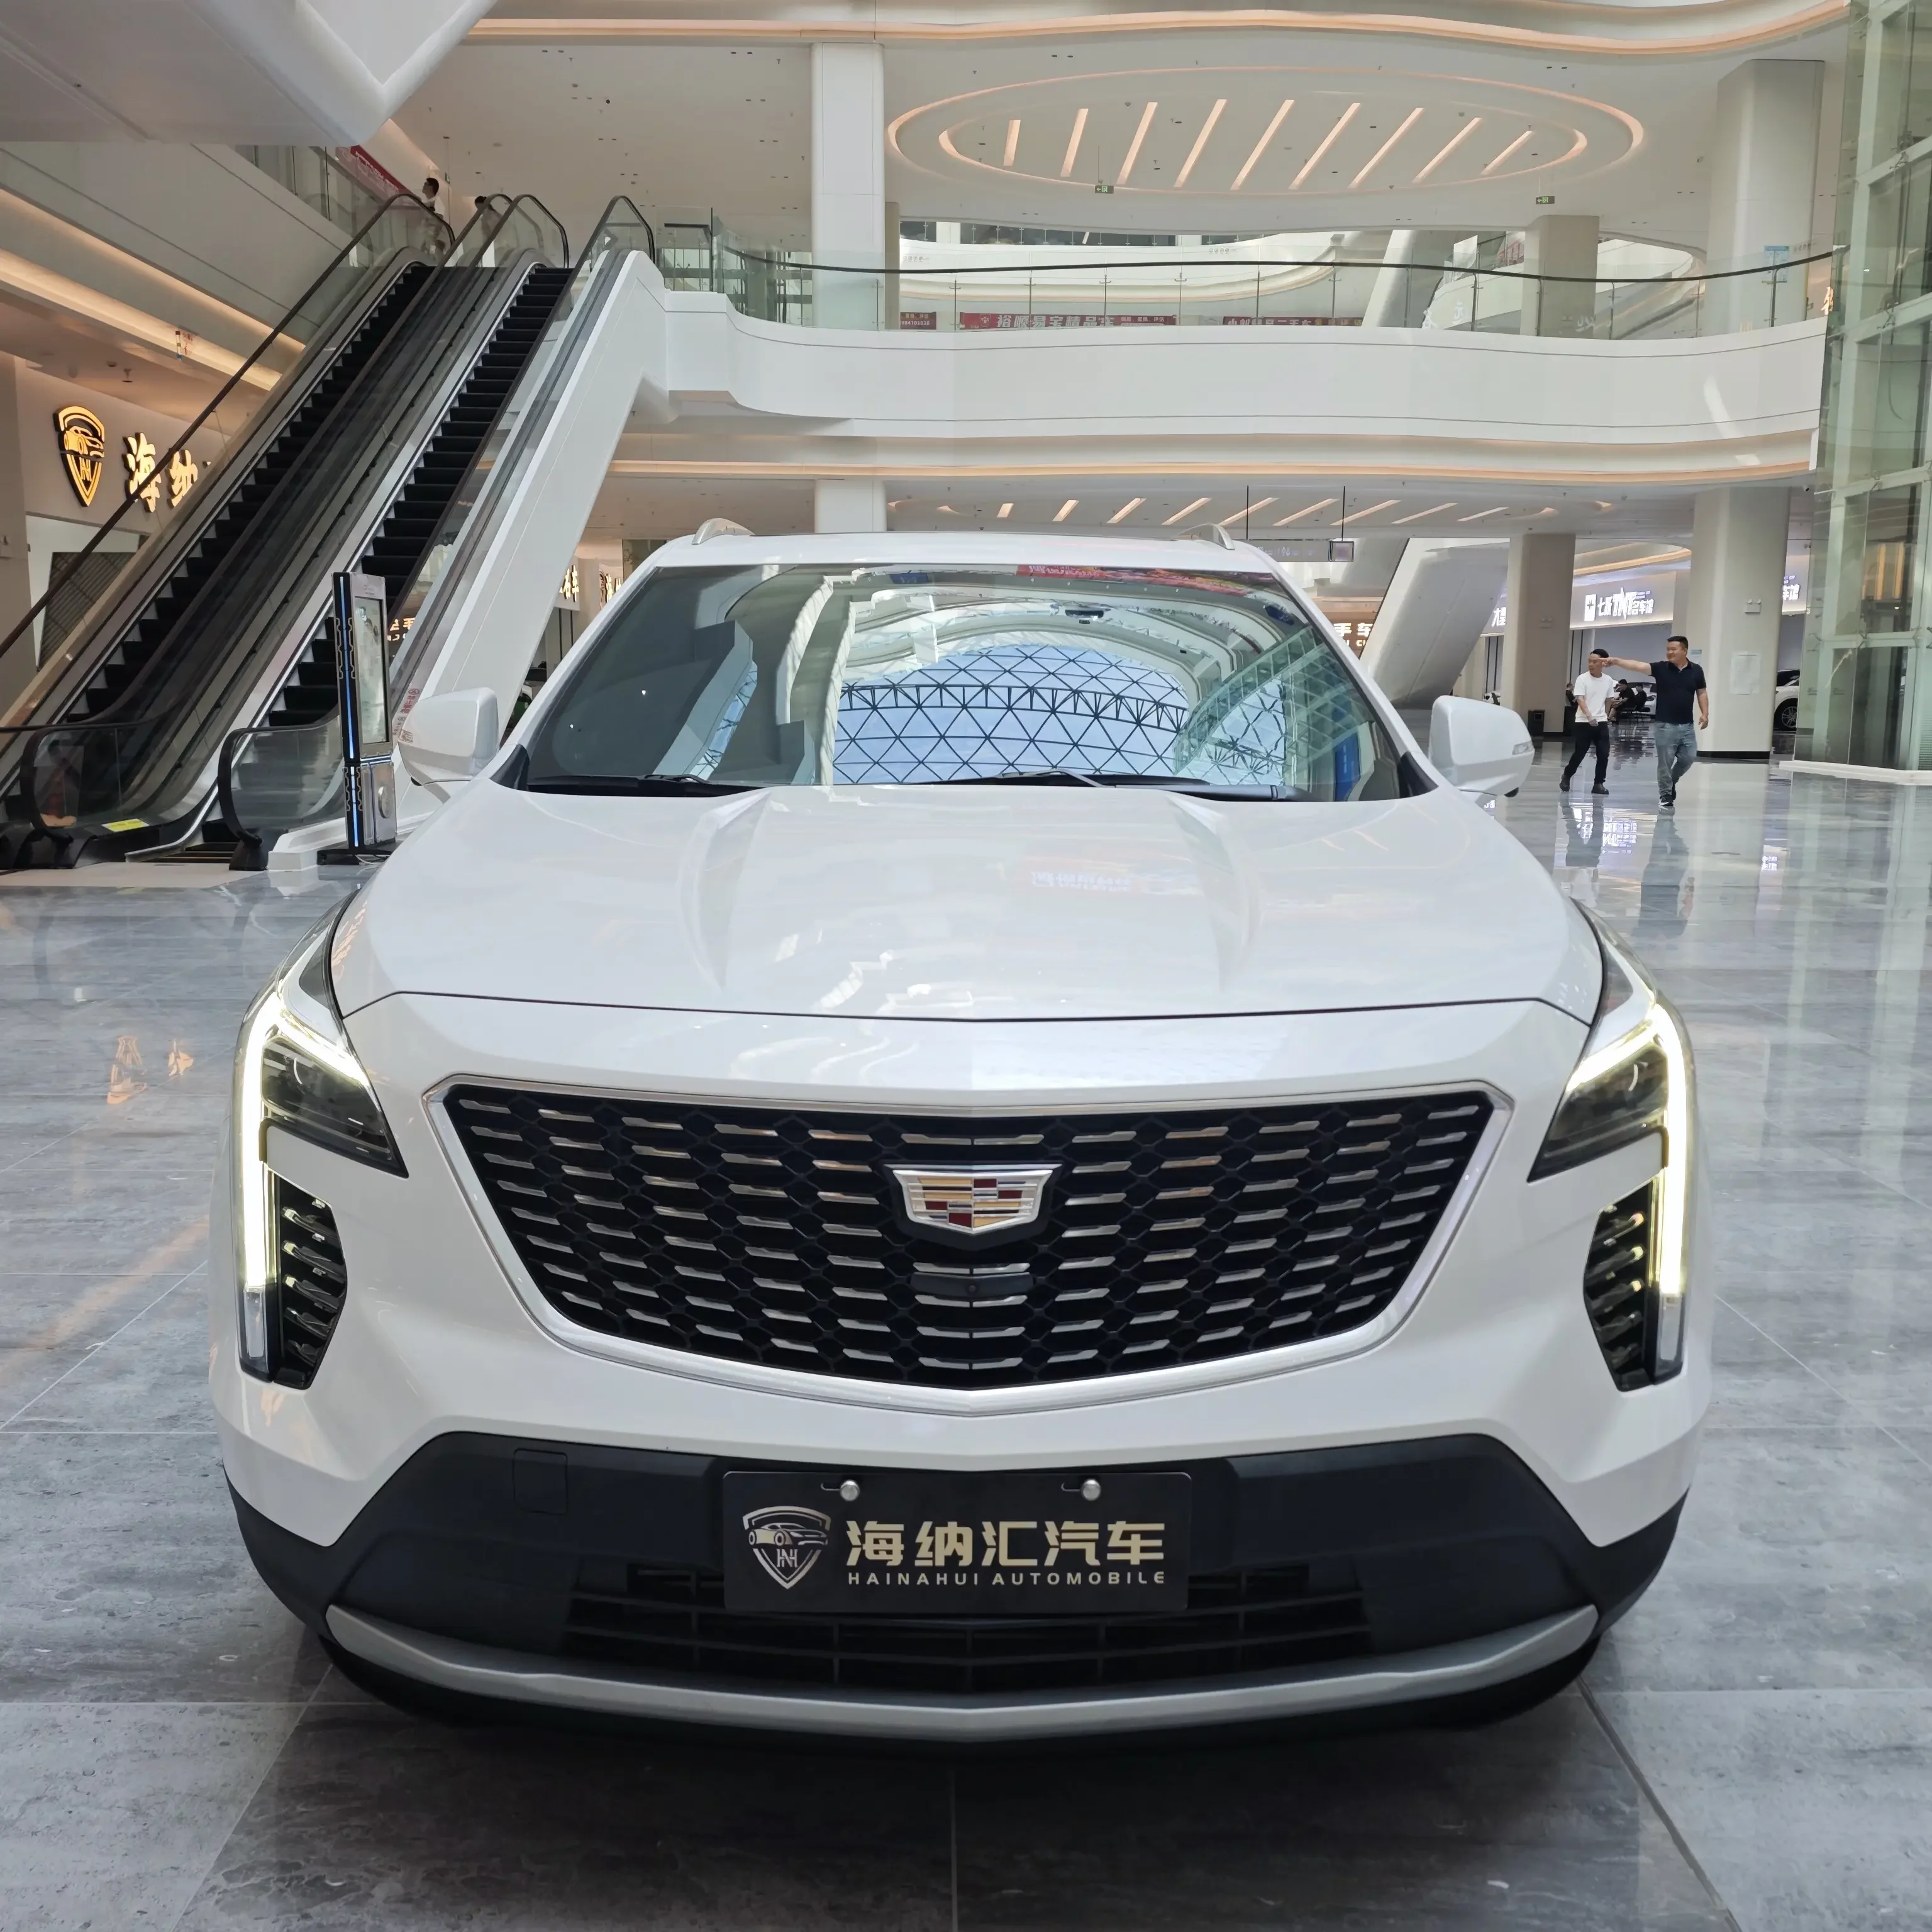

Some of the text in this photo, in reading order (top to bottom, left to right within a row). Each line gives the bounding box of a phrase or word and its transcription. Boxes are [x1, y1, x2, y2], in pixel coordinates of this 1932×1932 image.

[559, 564, 579, 602] 名车
[846, 1520, 1165, 1567] 海纳汇汽车
[848, 1571, 1165, 1585] HAINAHUI AUTOMOBILE
